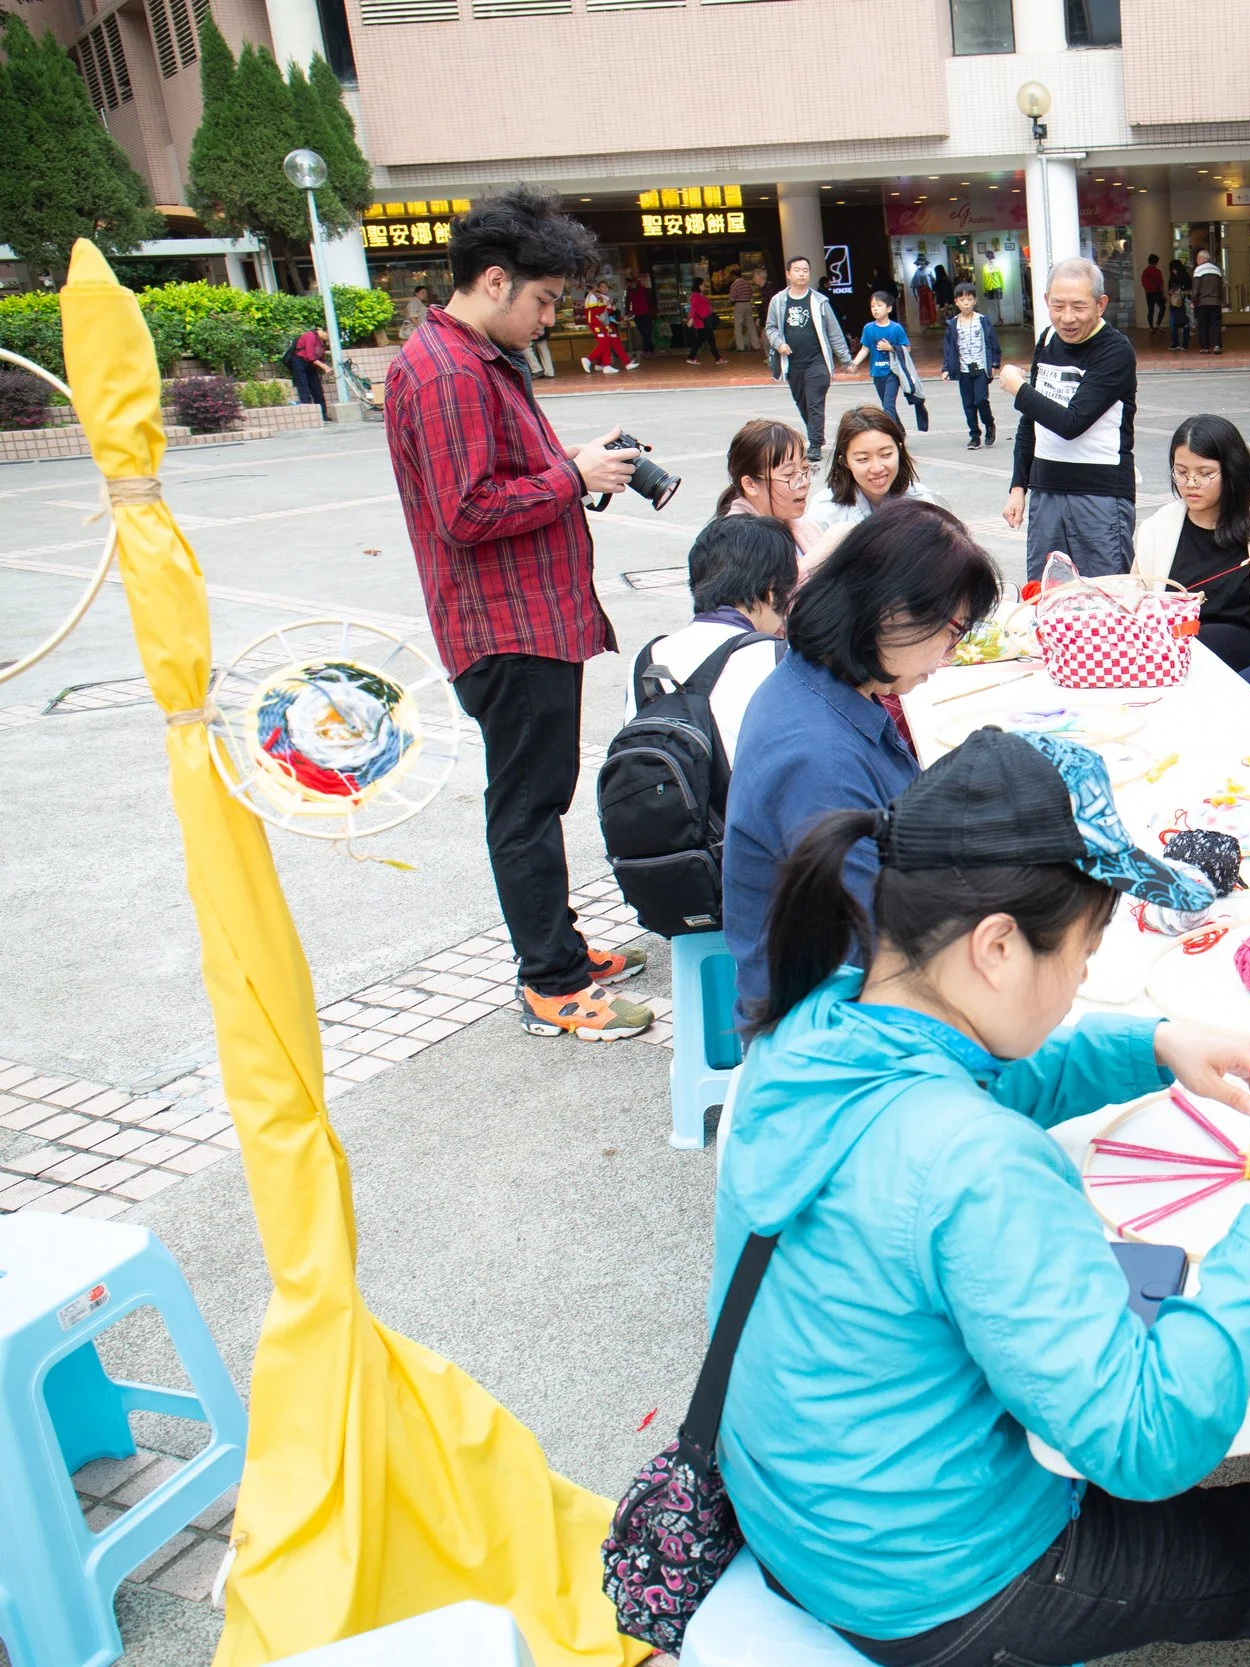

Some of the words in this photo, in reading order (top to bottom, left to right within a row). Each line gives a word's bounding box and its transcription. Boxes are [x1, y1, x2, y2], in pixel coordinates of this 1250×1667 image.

[367, 222, 452, 248] 聖安娜餅
[641, 212, 746, 236] 聖安娜餅屋
